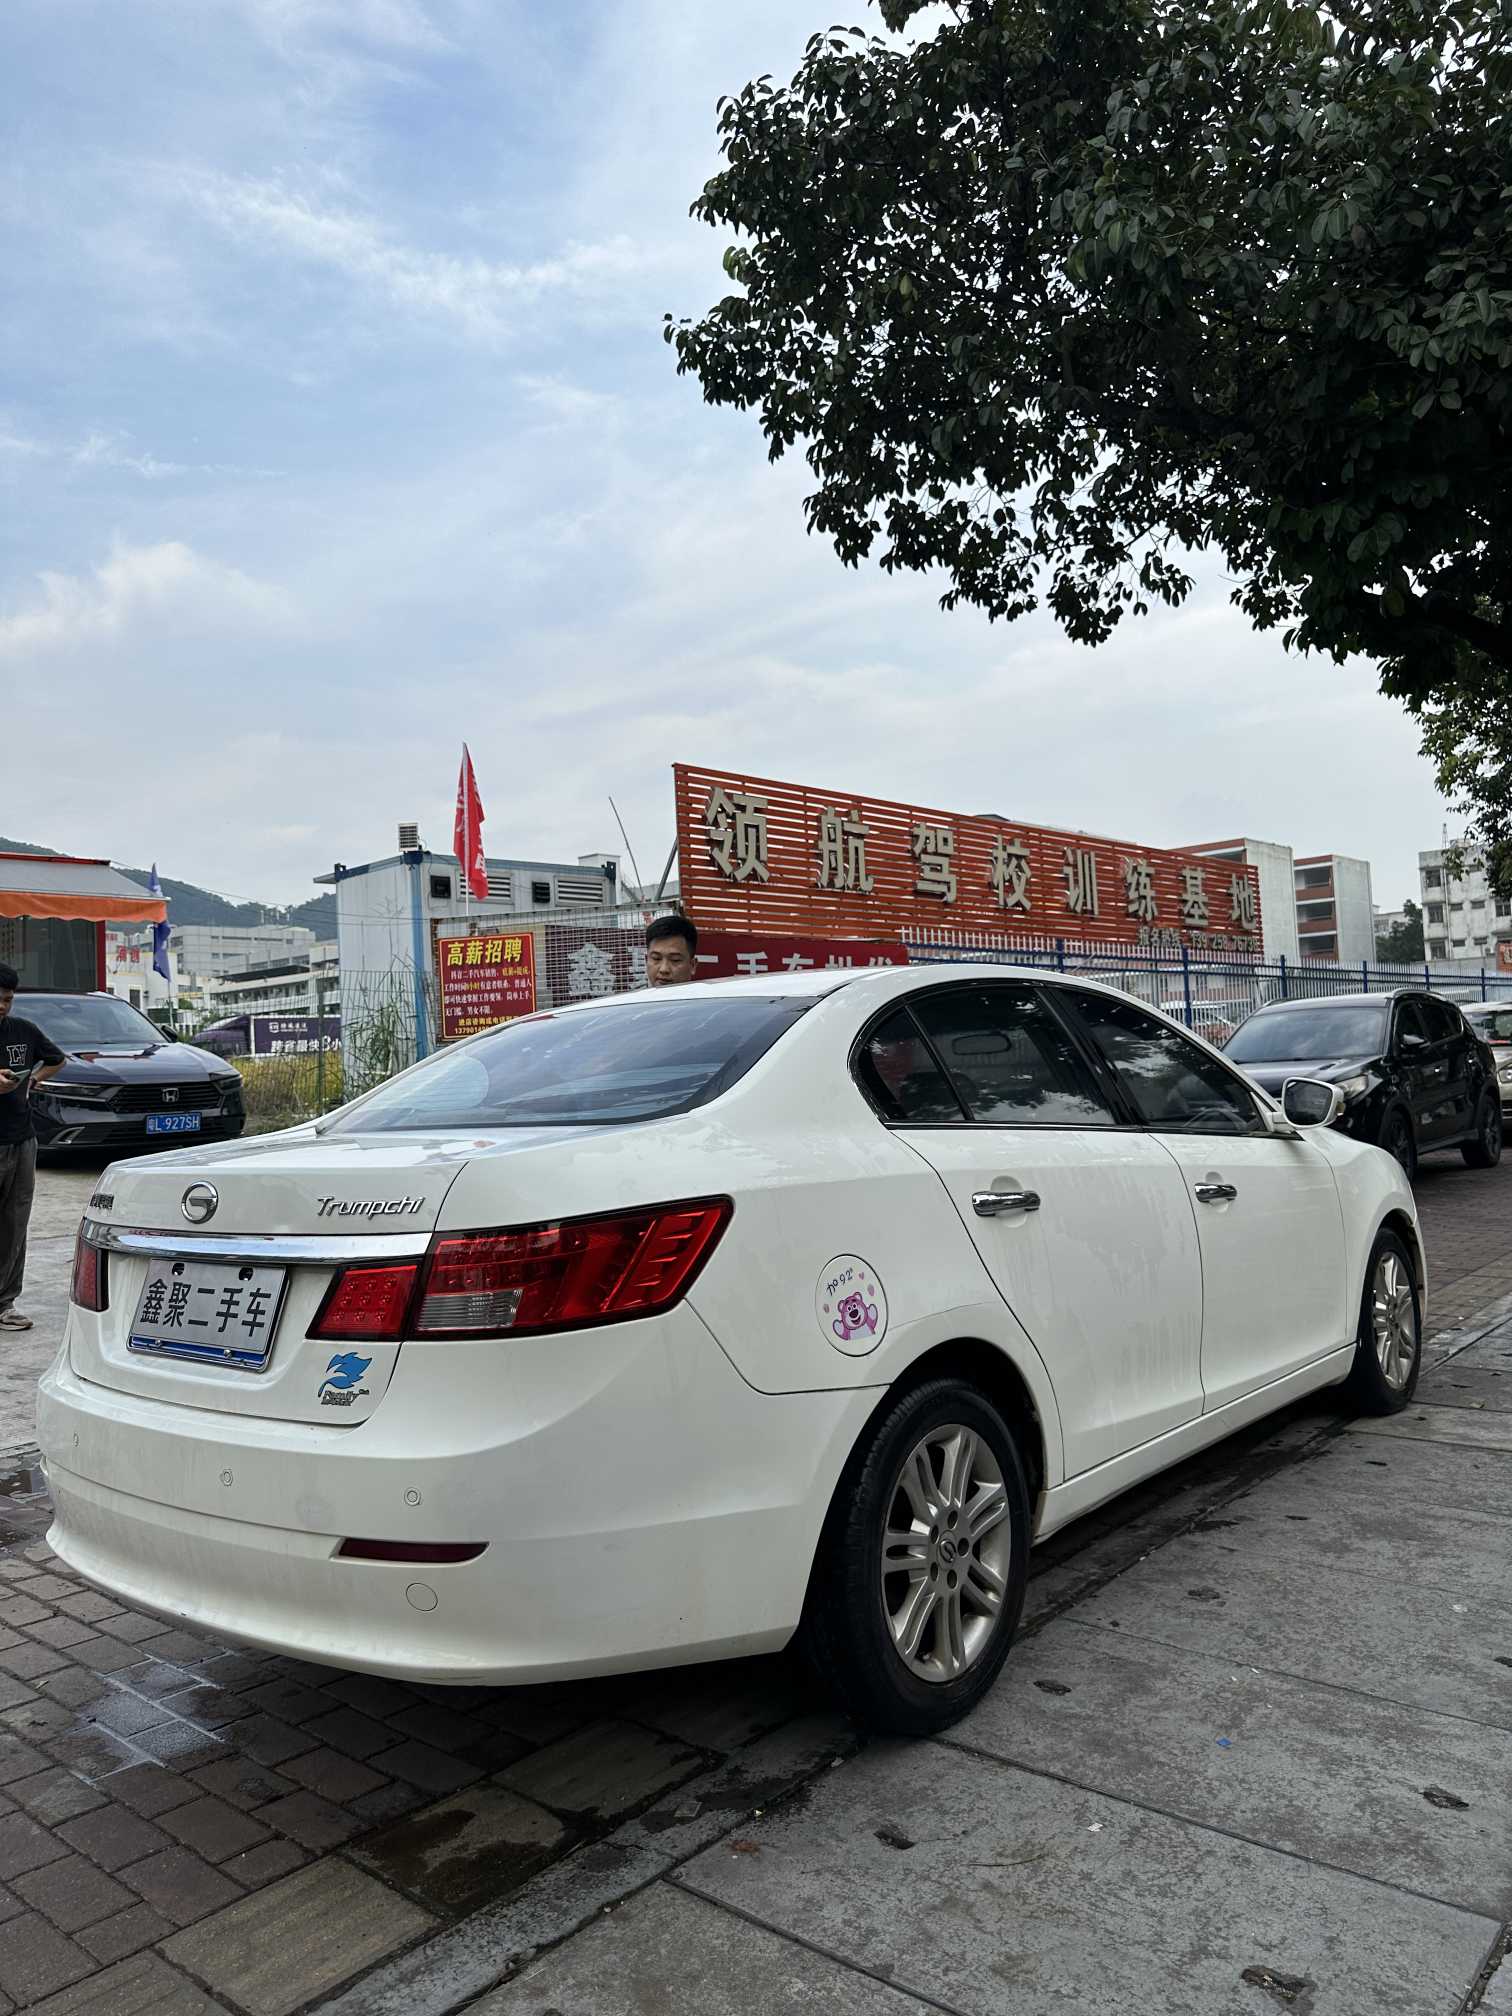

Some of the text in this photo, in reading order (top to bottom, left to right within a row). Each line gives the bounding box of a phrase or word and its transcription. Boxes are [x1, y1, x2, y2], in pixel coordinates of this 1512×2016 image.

[705, 786, 1256, 930] 领航驾校训练基地
[447, 937, 522, 966] 高薪招聘
[317, 1195, 426, 1221] Trumpchi
[139, 1278, 272, 1337] 鑫聚二手车
